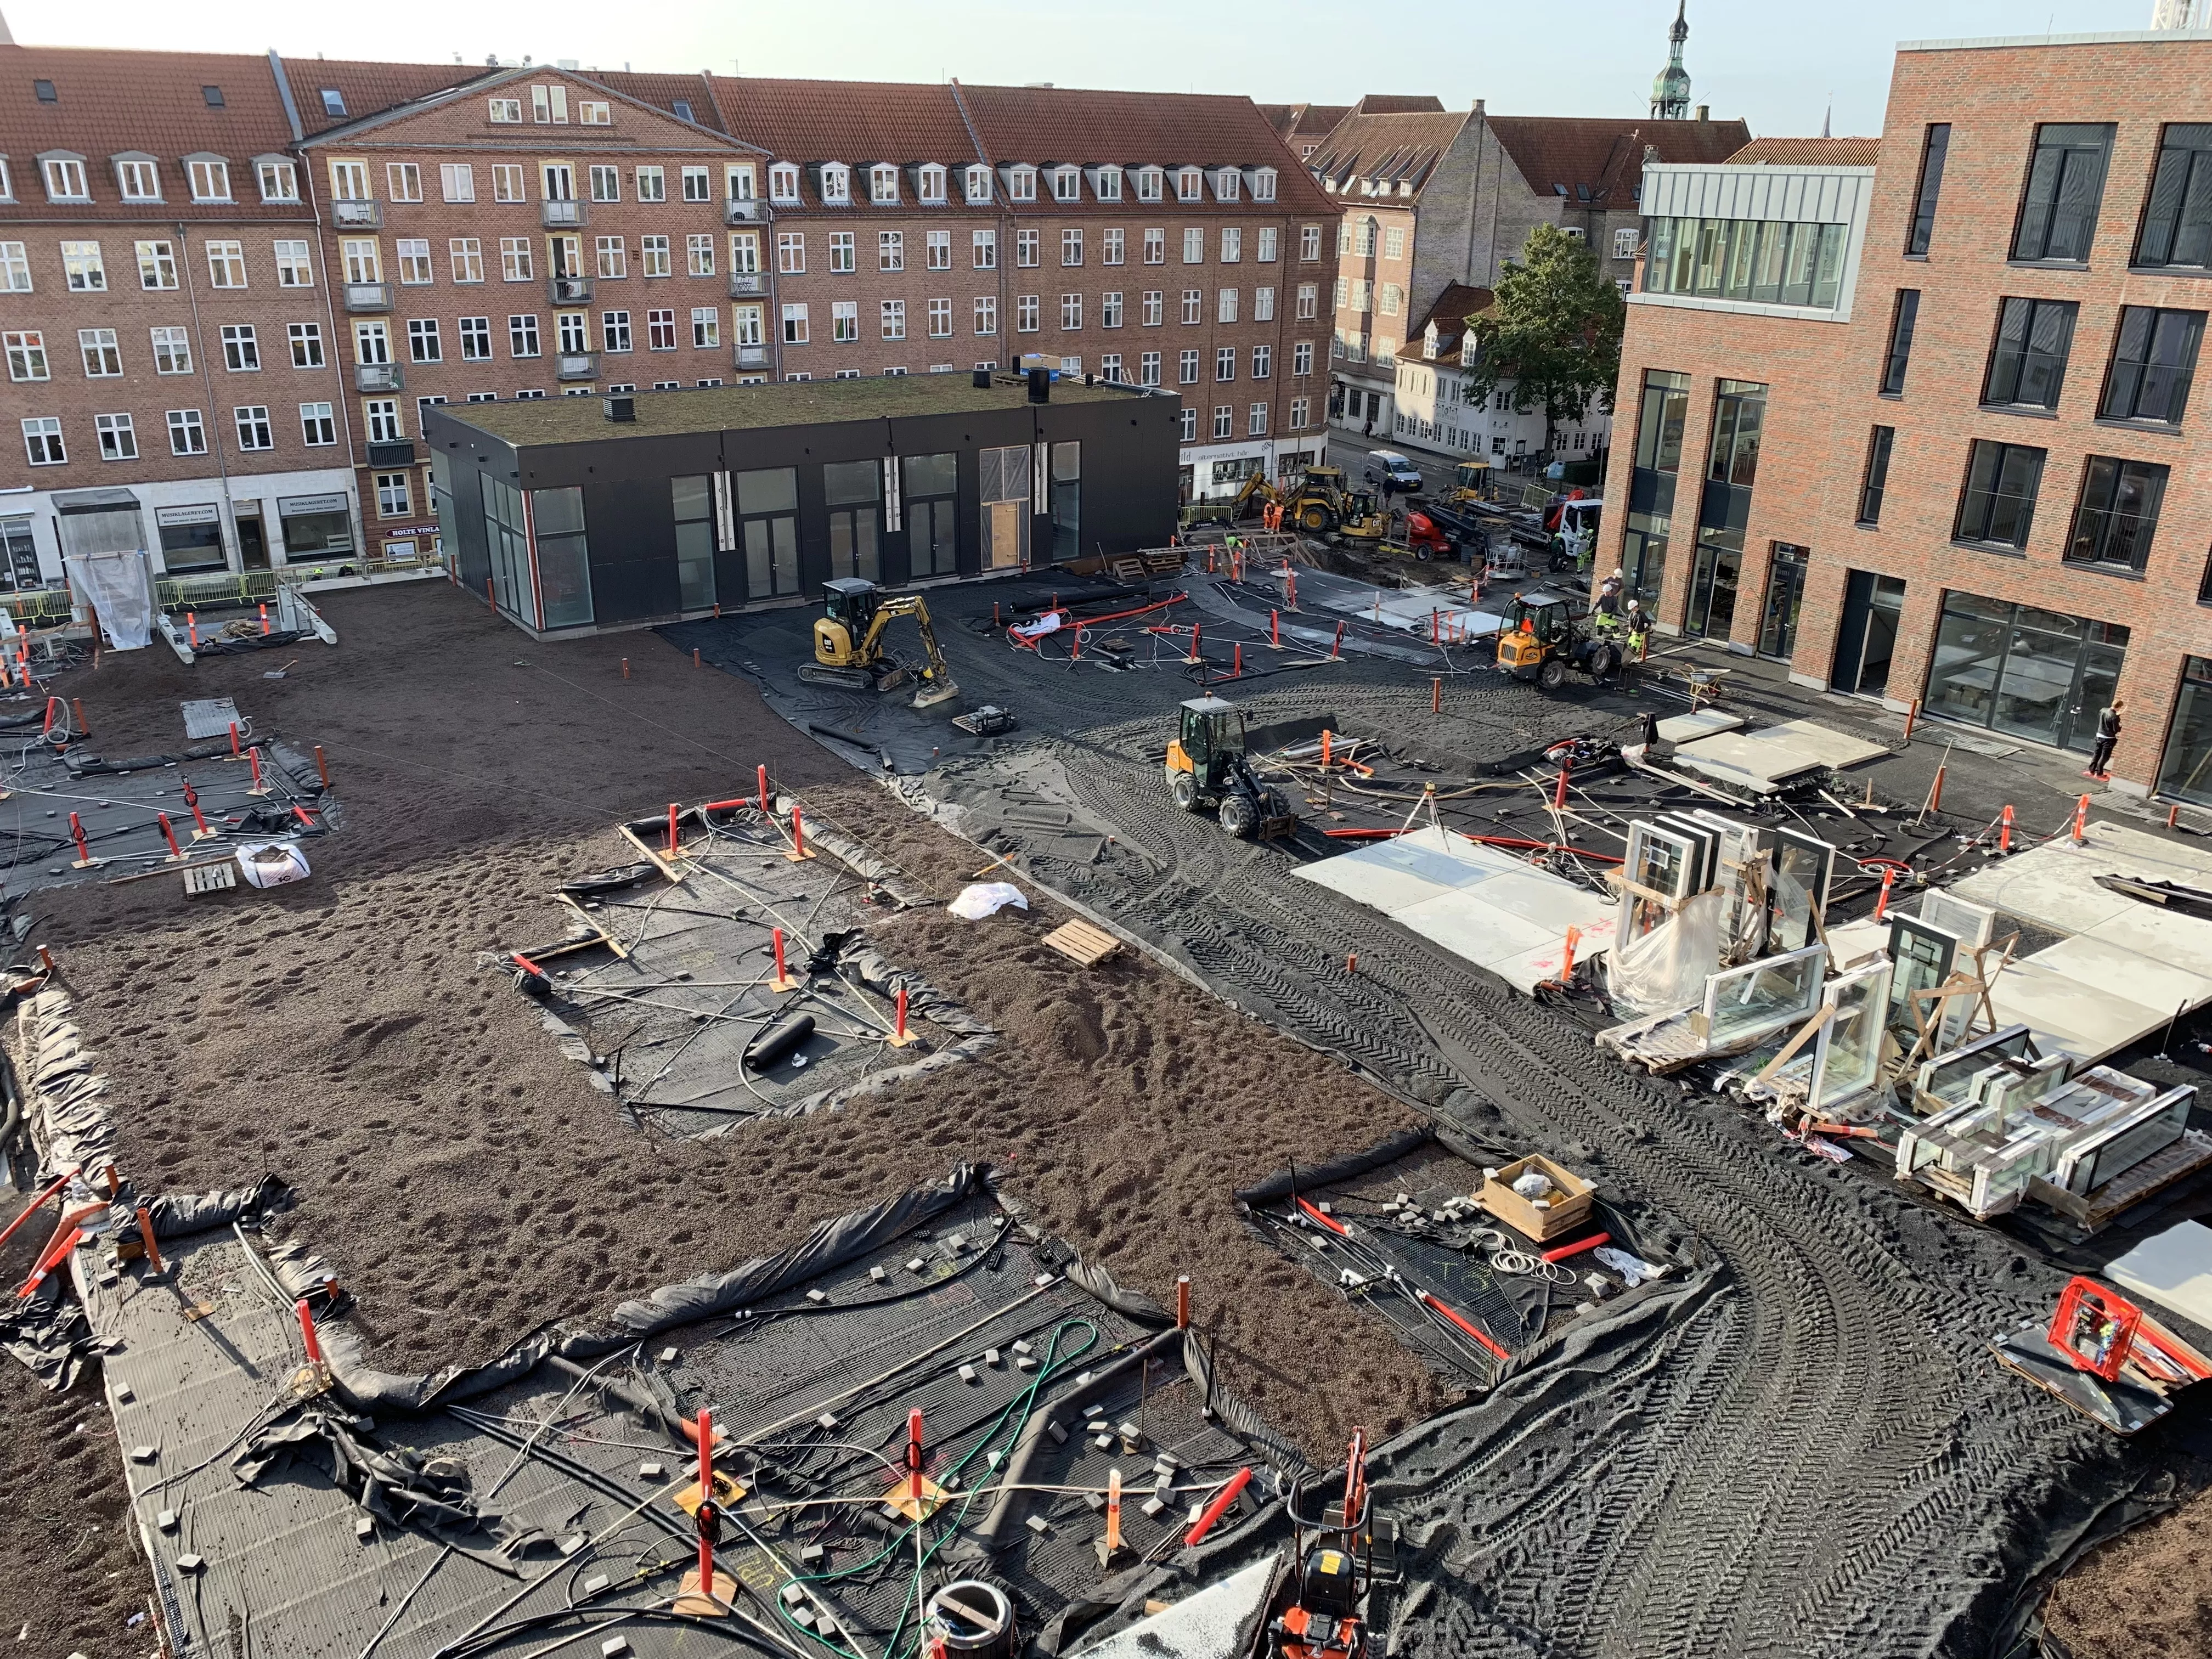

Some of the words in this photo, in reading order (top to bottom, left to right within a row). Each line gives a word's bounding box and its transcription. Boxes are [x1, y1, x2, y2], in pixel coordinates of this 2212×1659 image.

[1180, 451, 1191, 462] ild
[1198, 452, 1235, 461] alternativt
[290, 499, 337, 507] MUSIKLAGERET.COM
[161, 510, 213, 518] MUSIKLAGERET.COM
